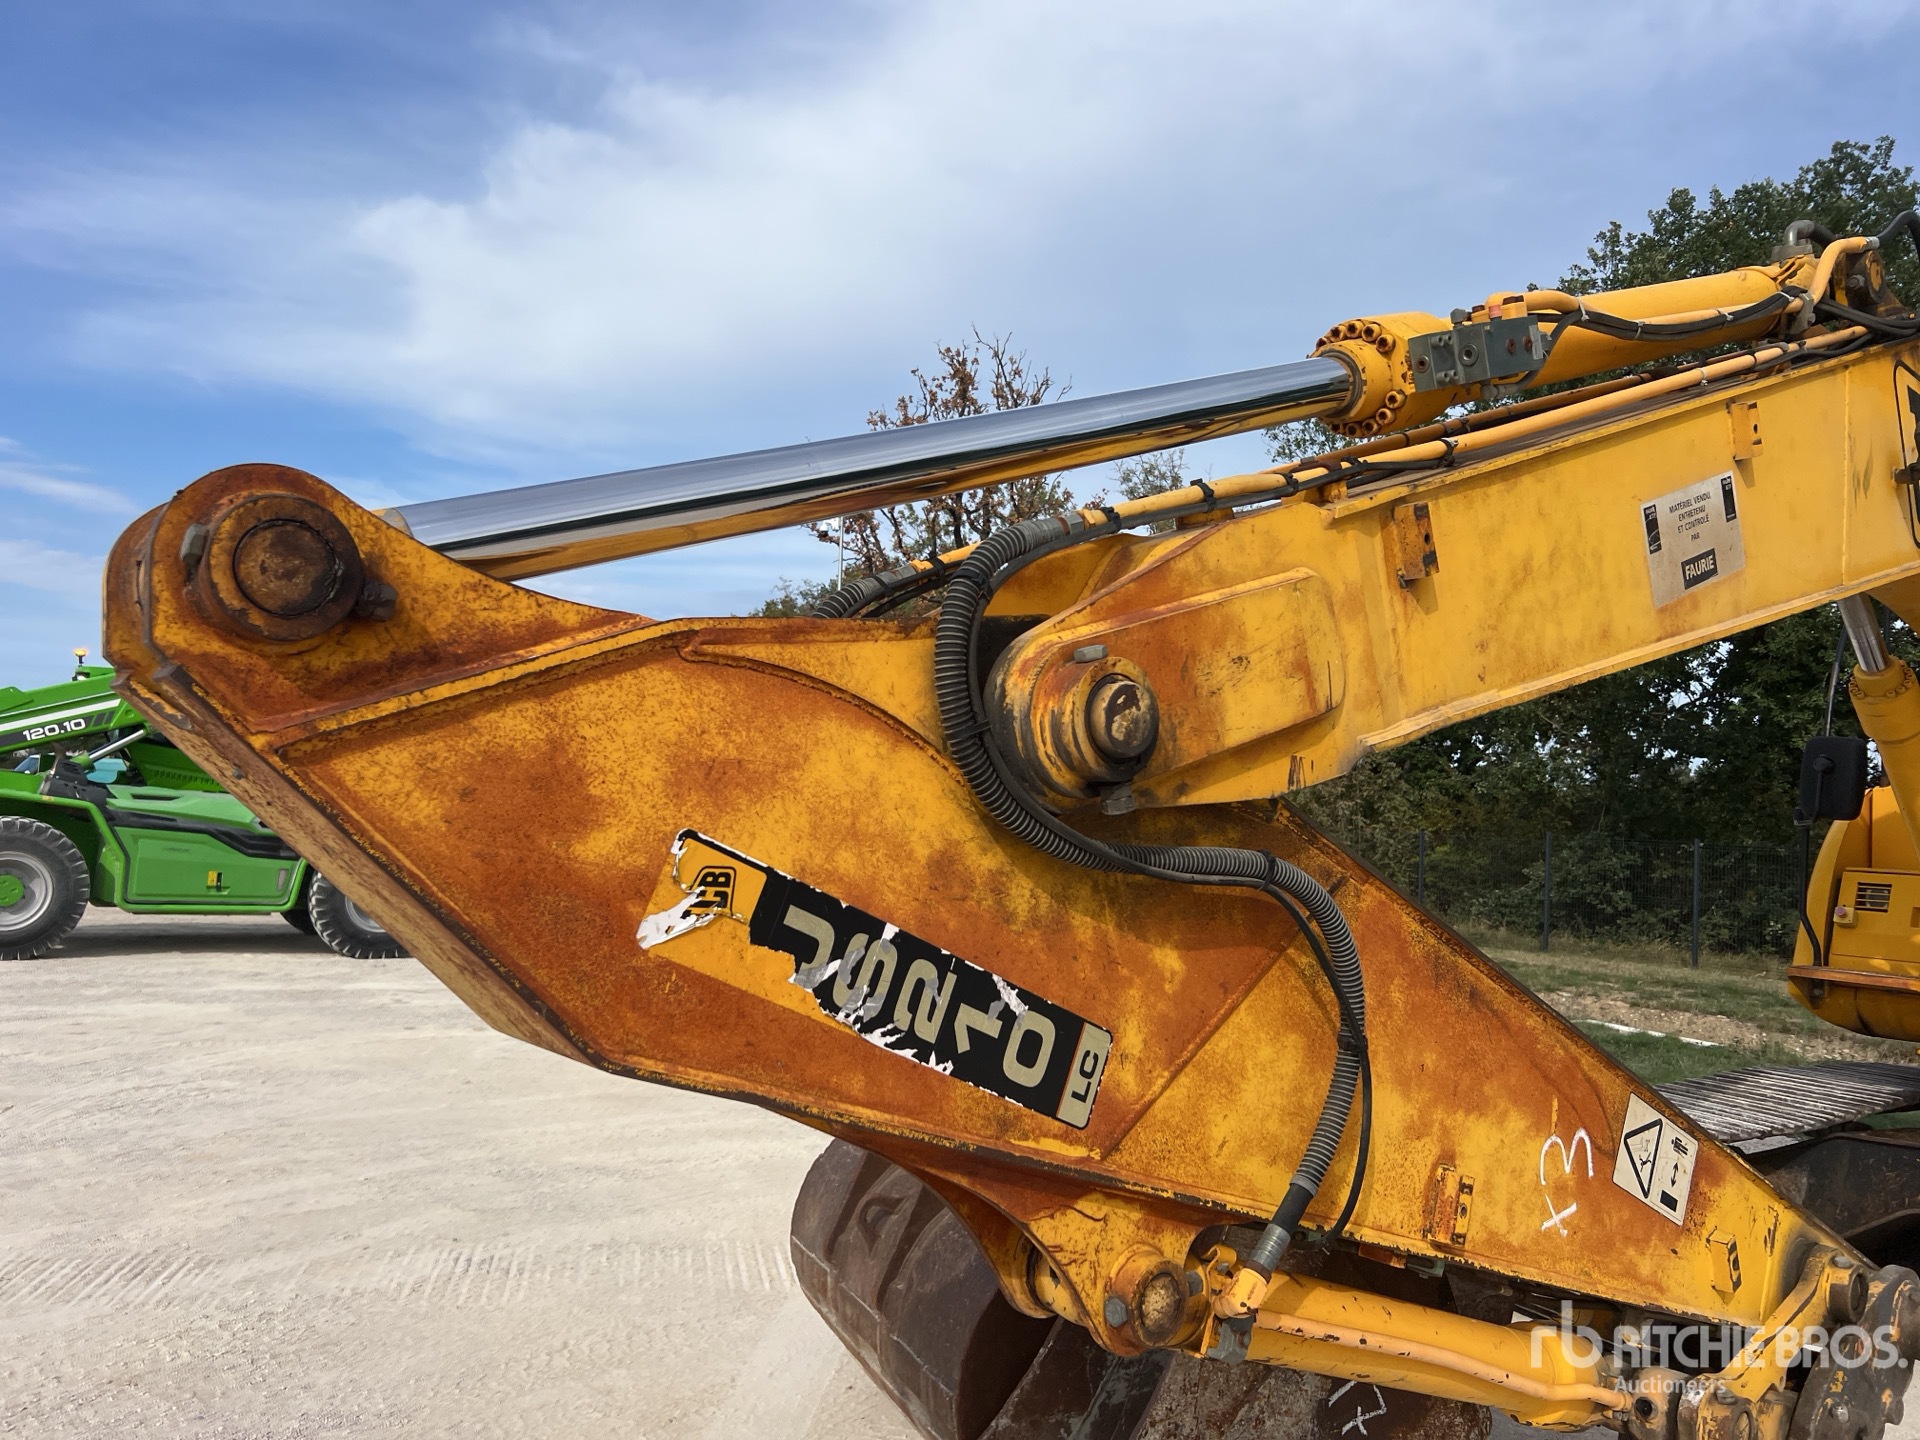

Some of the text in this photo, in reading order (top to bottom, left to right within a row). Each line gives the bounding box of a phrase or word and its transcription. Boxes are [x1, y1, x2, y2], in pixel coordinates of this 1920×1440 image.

[1678, 504, 1706, 522] ENTRETENU
[1677, 524, 1684, 534] ET
[1690, 531, 1701, 541] PAR
[1685, 554, 1715, 580] FAURIE
[22, 718, 86, 741] 120.10
[681, 869, 732, 919] CB
[1070, 1049, 1100, 1104] LC
